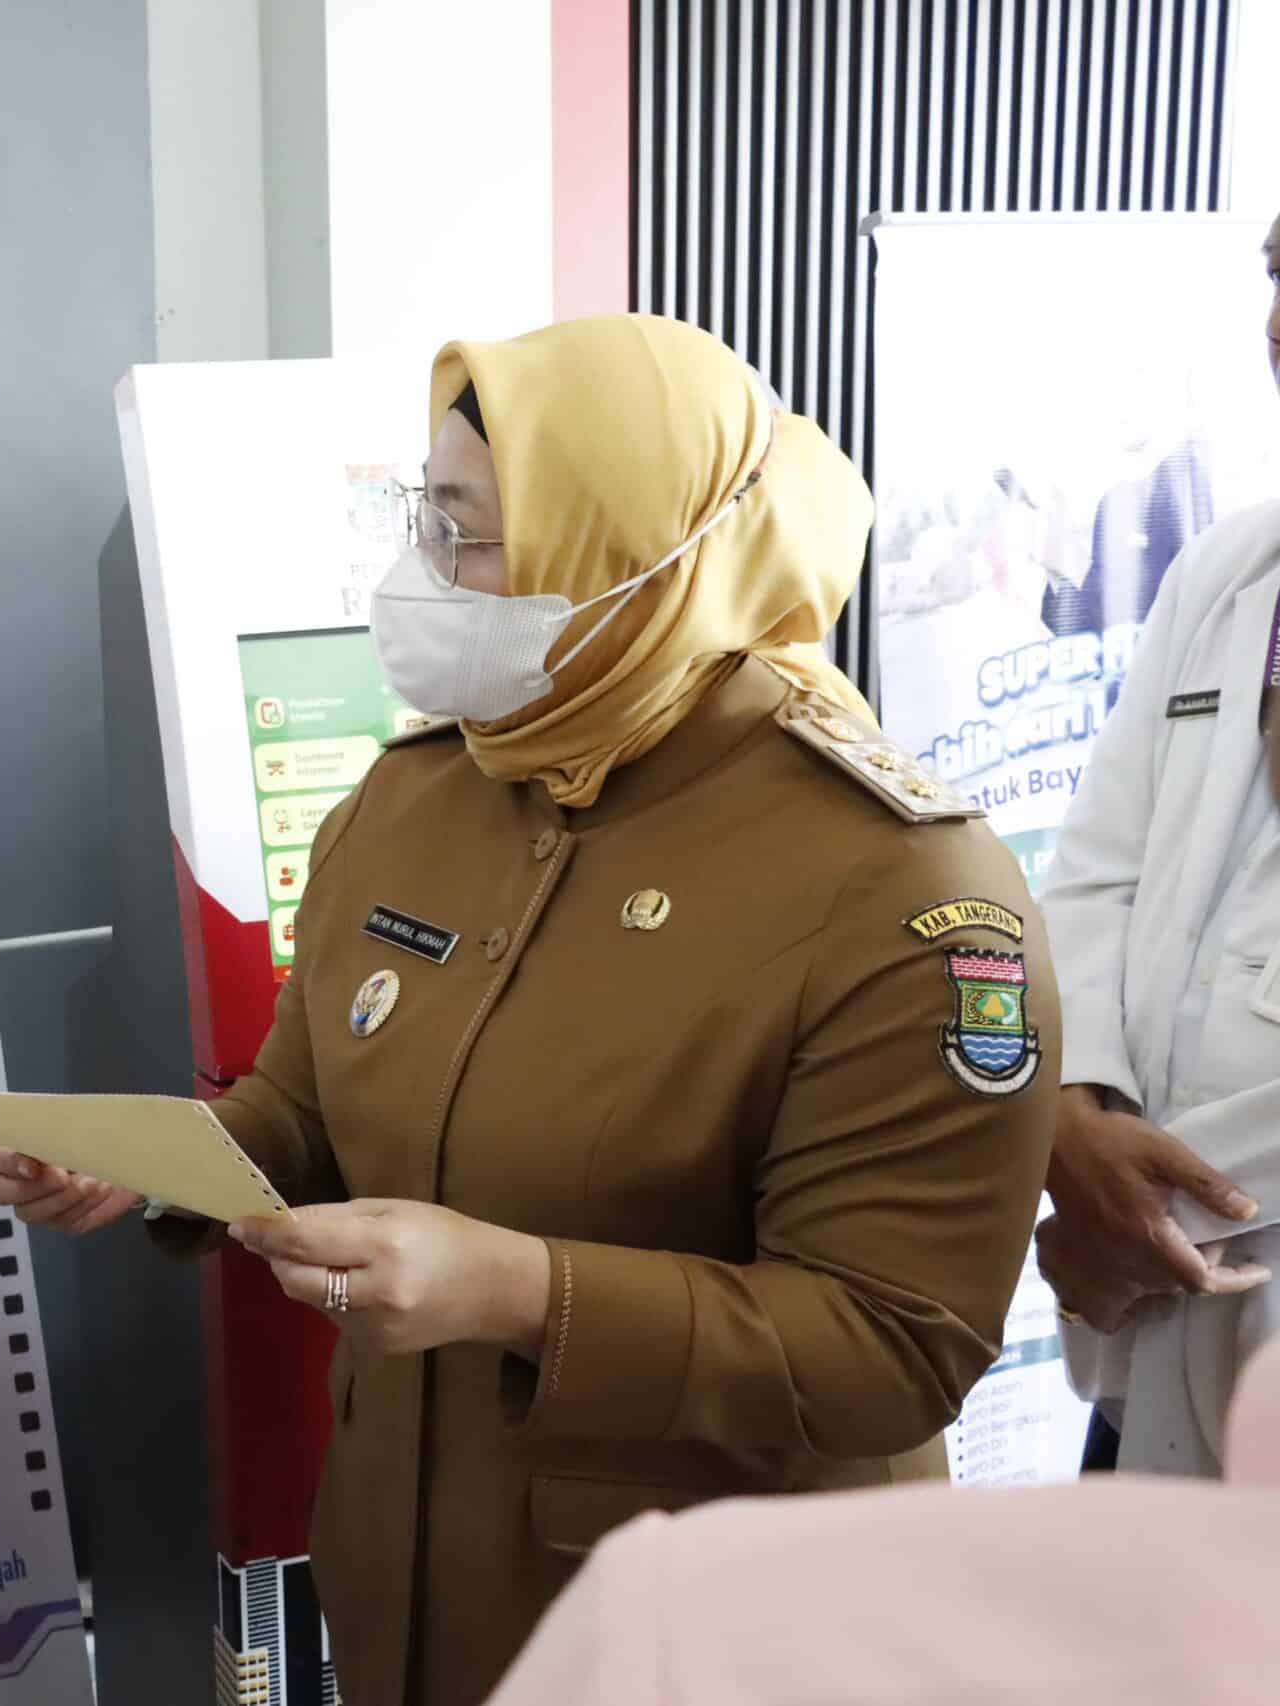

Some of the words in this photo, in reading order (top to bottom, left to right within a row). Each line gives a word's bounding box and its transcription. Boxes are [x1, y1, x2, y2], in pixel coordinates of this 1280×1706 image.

[977, 630, 1102, 708] SUPER
[1028, 765, 1086, 796] Bay
[918, 910, 956, 934] KAB.
[955, 903, 1018, 933] TANGERANG
